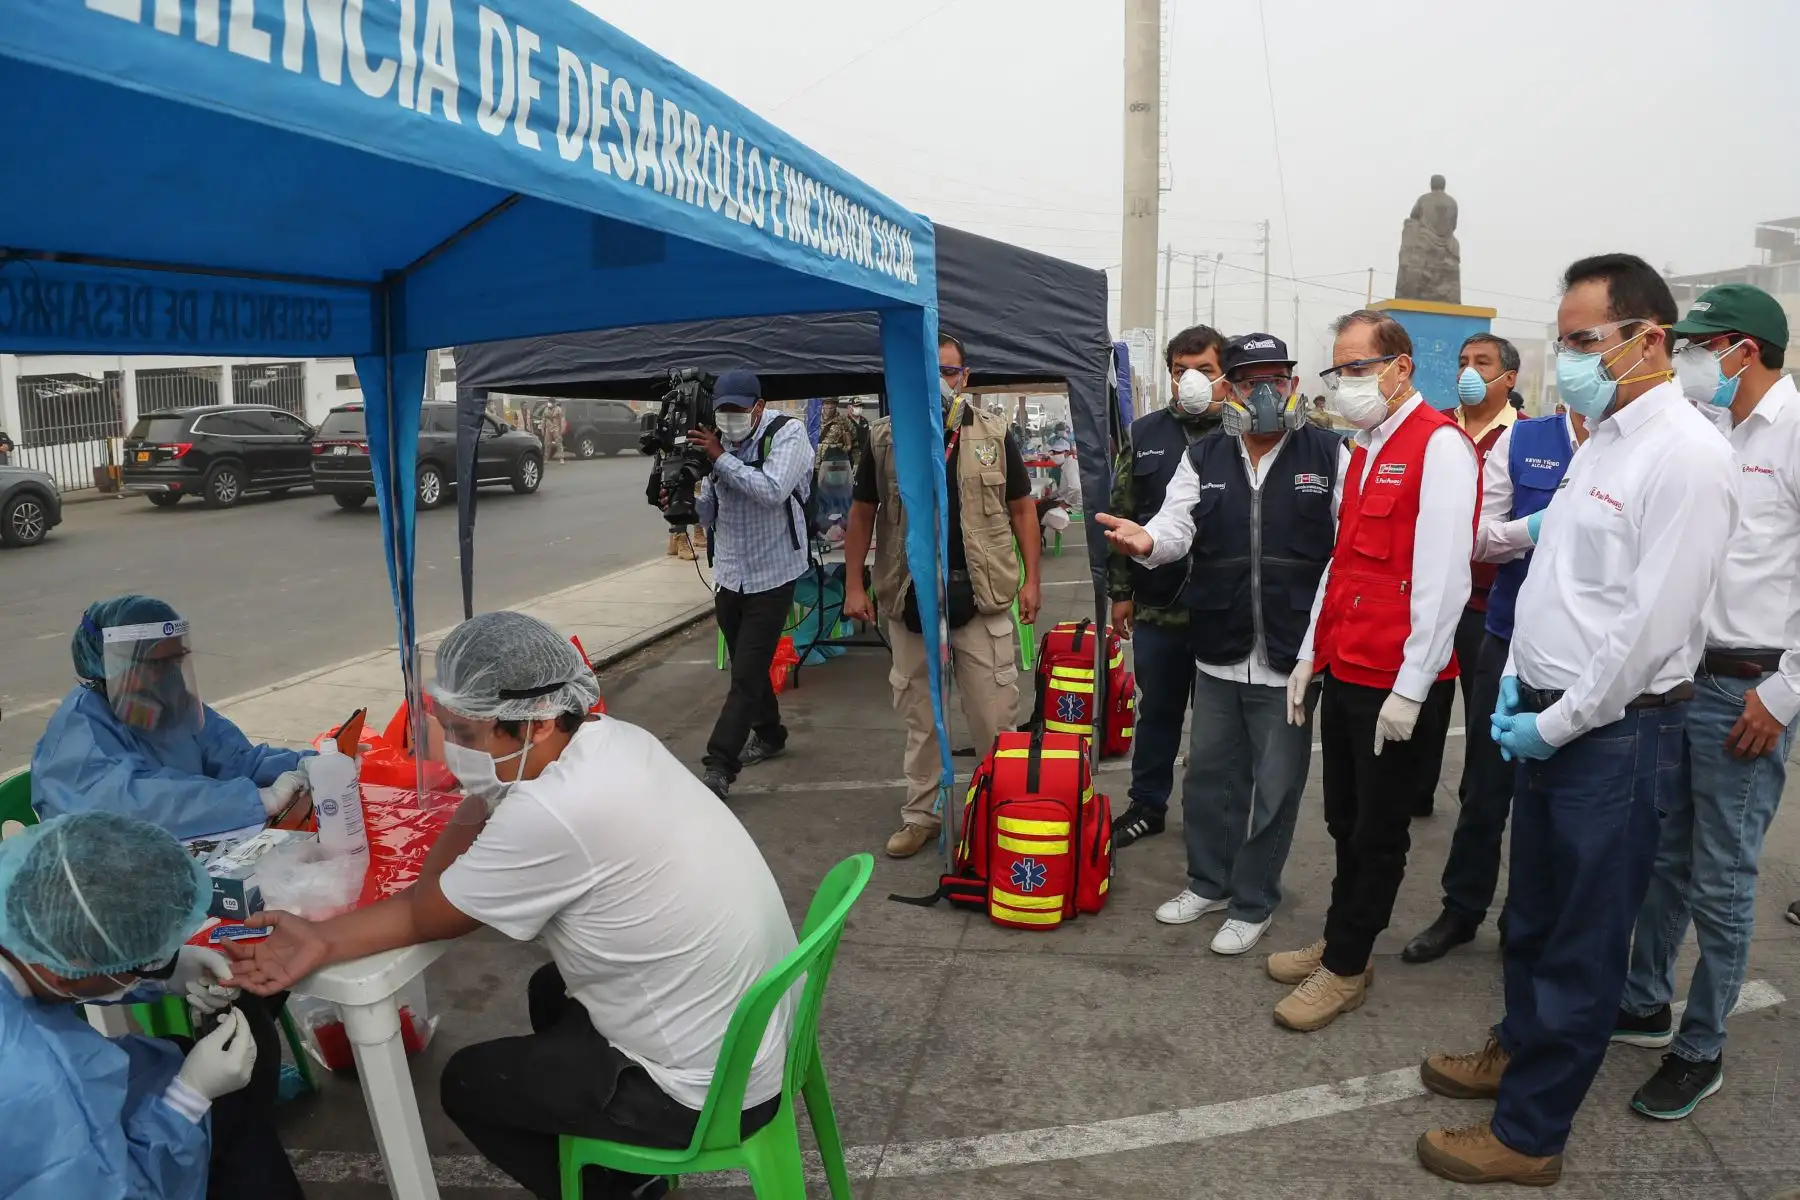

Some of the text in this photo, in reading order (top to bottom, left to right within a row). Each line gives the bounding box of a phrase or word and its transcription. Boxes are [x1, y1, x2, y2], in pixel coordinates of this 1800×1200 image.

[477, 5, 541, 151] DE
[556, 45, 765, 229] DESARROLLO
[769, 157, 783, 237] E
[784, 164, 873, 269] INCLUSION
[872, 215, 917, 285] SOCIAL
